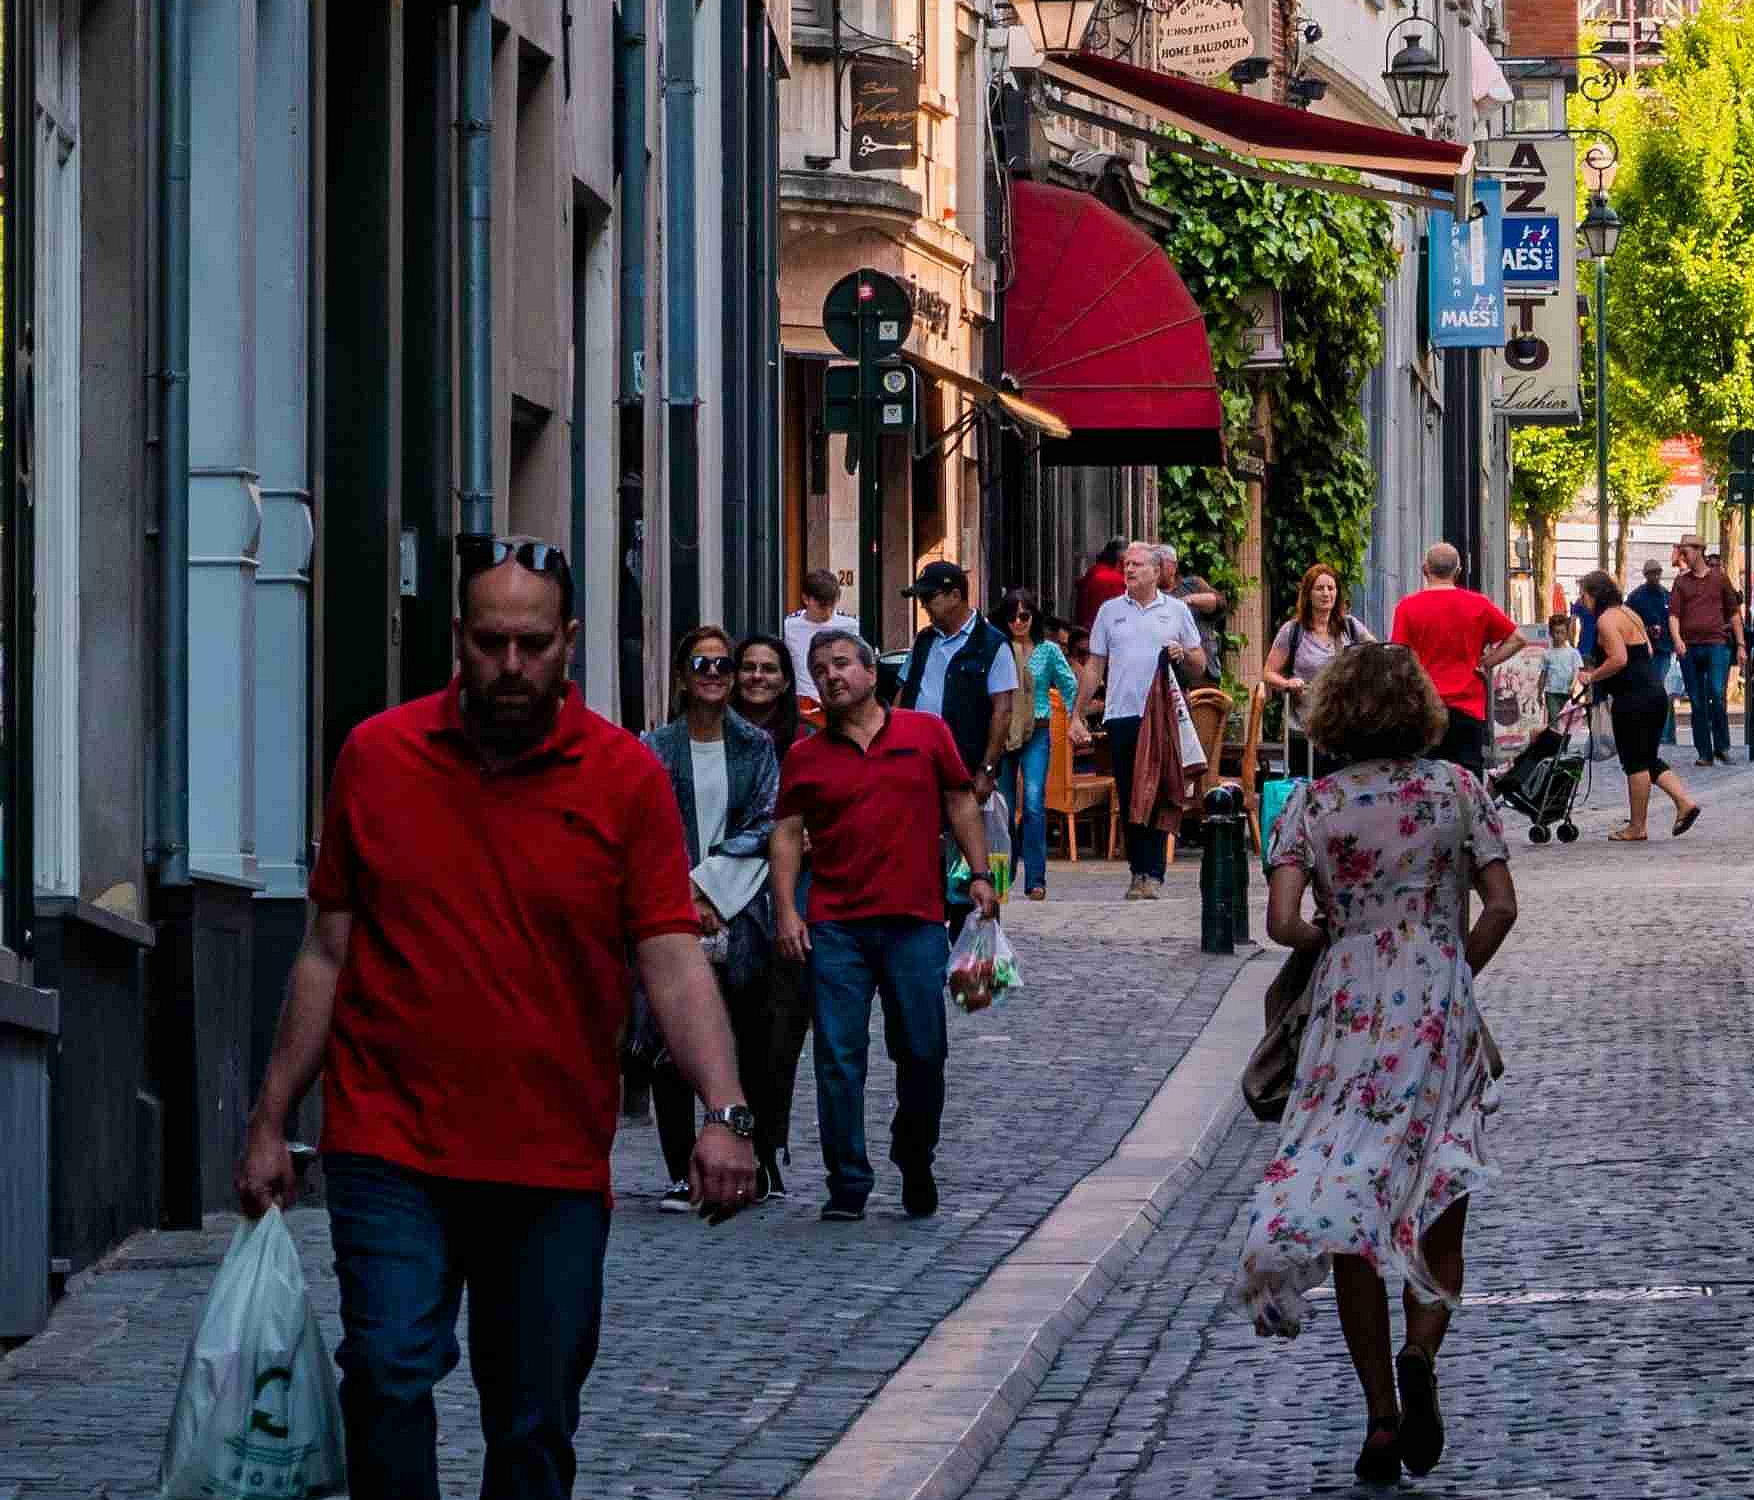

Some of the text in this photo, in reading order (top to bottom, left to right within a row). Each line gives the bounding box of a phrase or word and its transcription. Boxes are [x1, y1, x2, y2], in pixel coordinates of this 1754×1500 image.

[1161, 36, 1249, 58] HOME BAUDOUIN
[1502, 247, 1542, 270] AES
[1504, 142, 1549, 371] AZTO
[1440, 309, 1490, 328] MAES
[839, 569, 854, 586] 20
